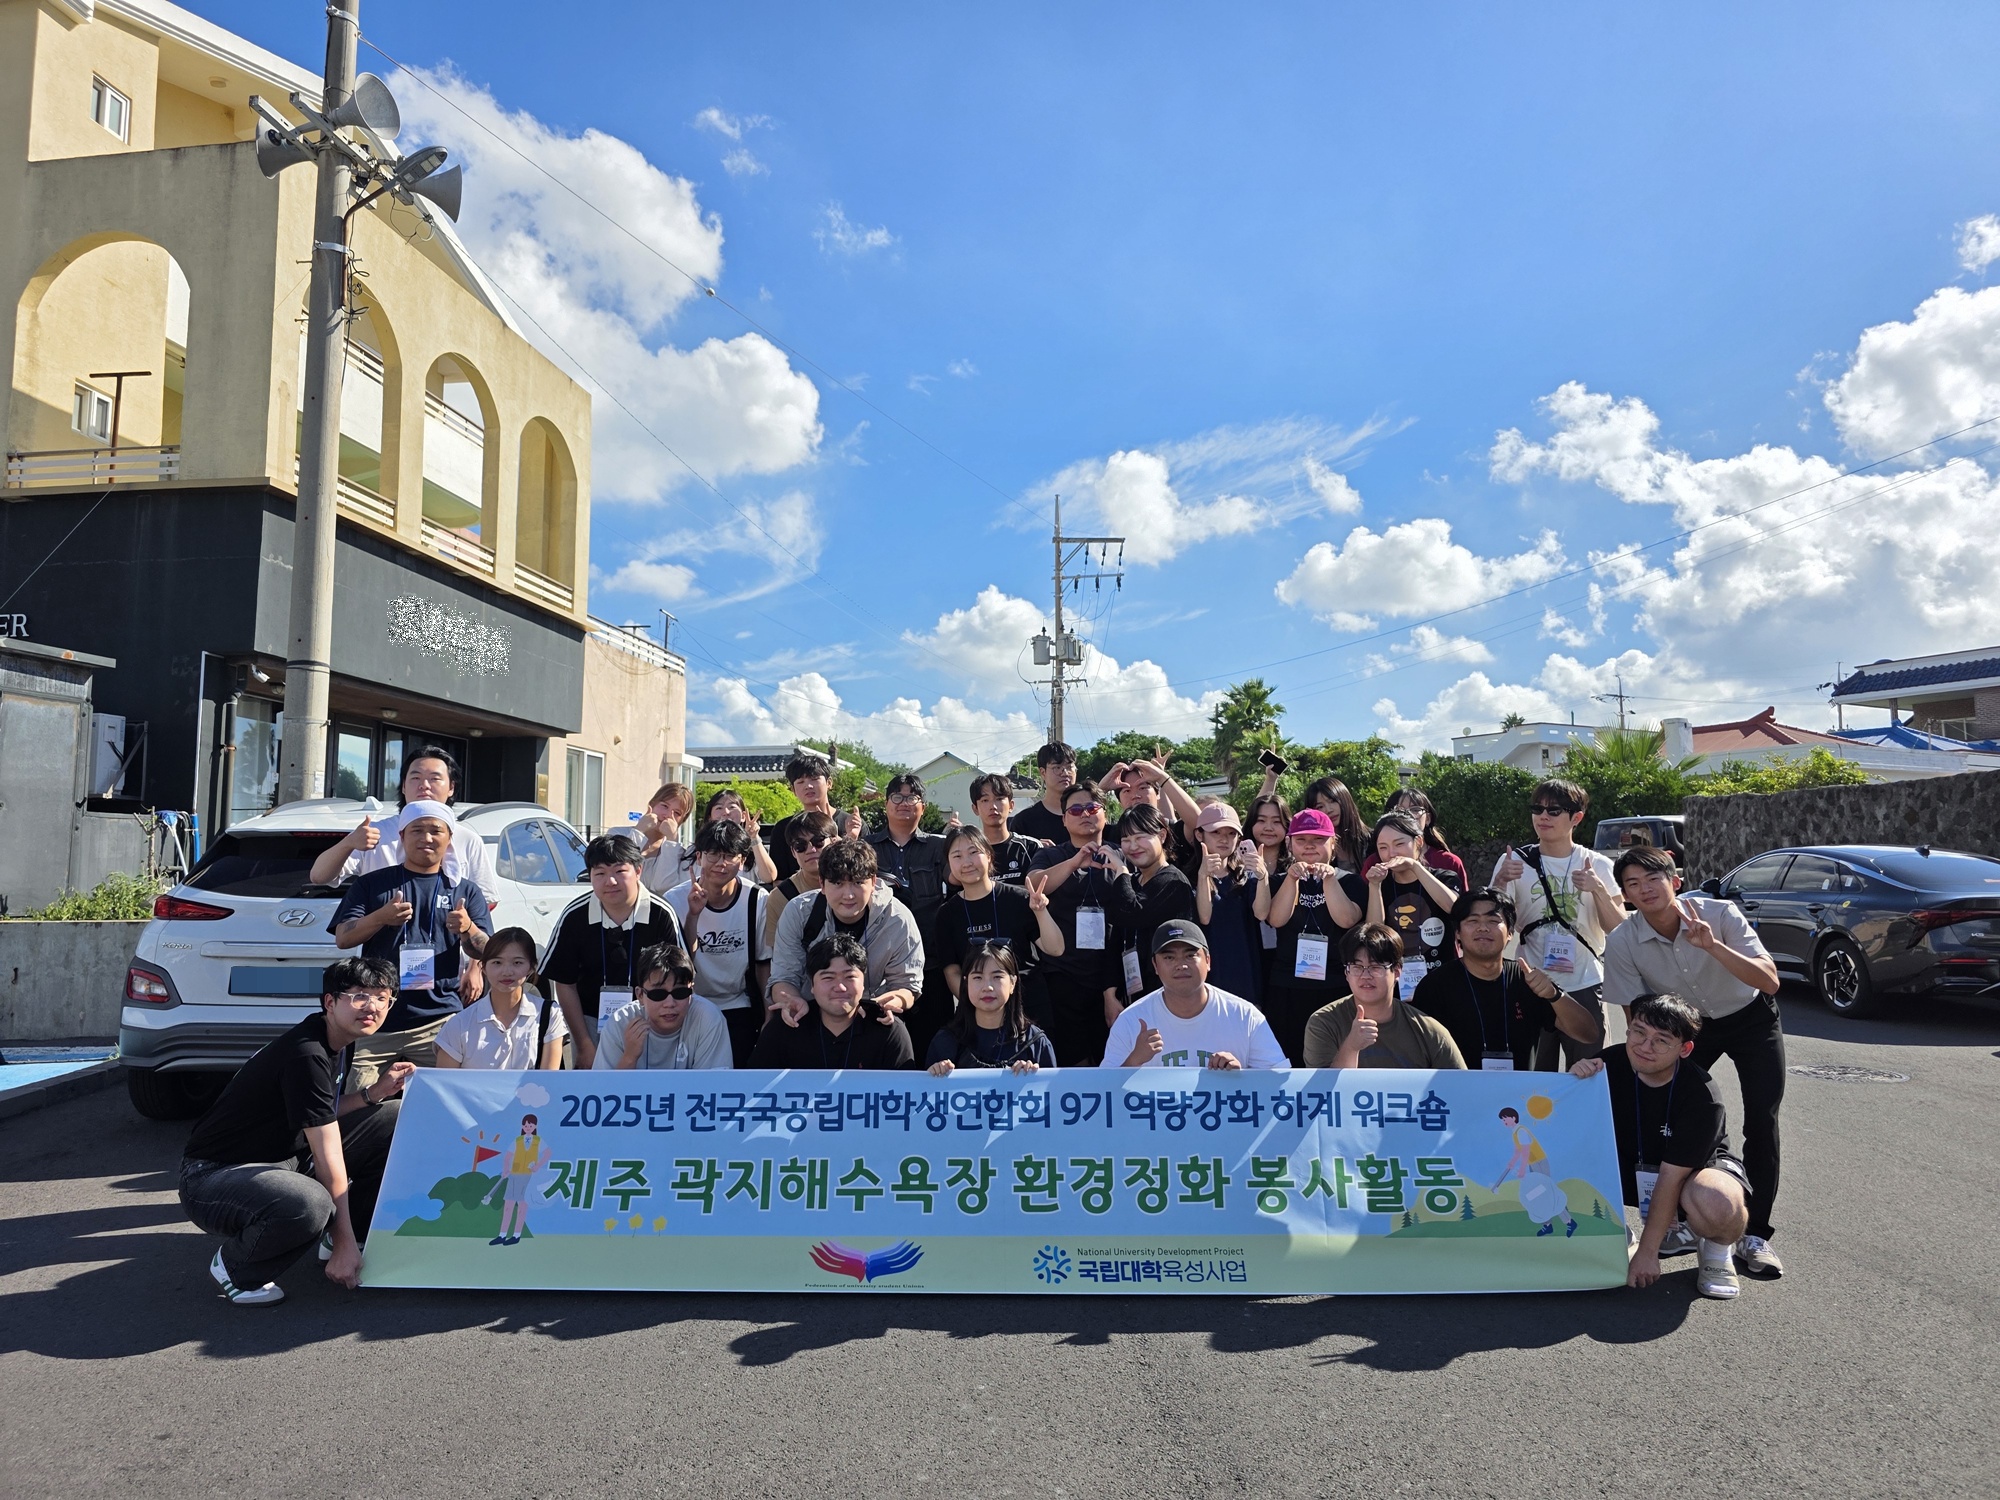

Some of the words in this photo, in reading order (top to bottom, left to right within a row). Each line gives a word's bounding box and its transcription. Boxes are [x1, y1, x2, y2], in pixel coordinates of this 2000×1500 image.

[966, 923, 992, 932] GUESS
[161, 942, 193, 950] KONA
[560, 1093, 675, 1132] 2025년
[685, 1089, 1050, 1132] 전국국공립대학생연합회
[1060, 1091, 1113, 1128] 9기
[1123, 1089, 1264, 1131] 역량강화
[1270, 1089, 1342, 1128] 하계
[1351, 1090, 1451, 1131] 워크숍
[541, 1158, 652, 1212] 제주
[669, 1155, 998, 1215] 곽지해수욕장
[1012, 1154, 1232, 1215] 환경정화
[1246, 1153, 1465, 1214] 봉사활동
[1077, 1248, 1109, 1256] National
[1113, 1248, 1155, 1257] University
[1157, 1248, 1211, 1257] Development
[1213, 1248, 1244, 1257] Project
[1078, 1260, 1247, 1282] 국립대학육성사업
